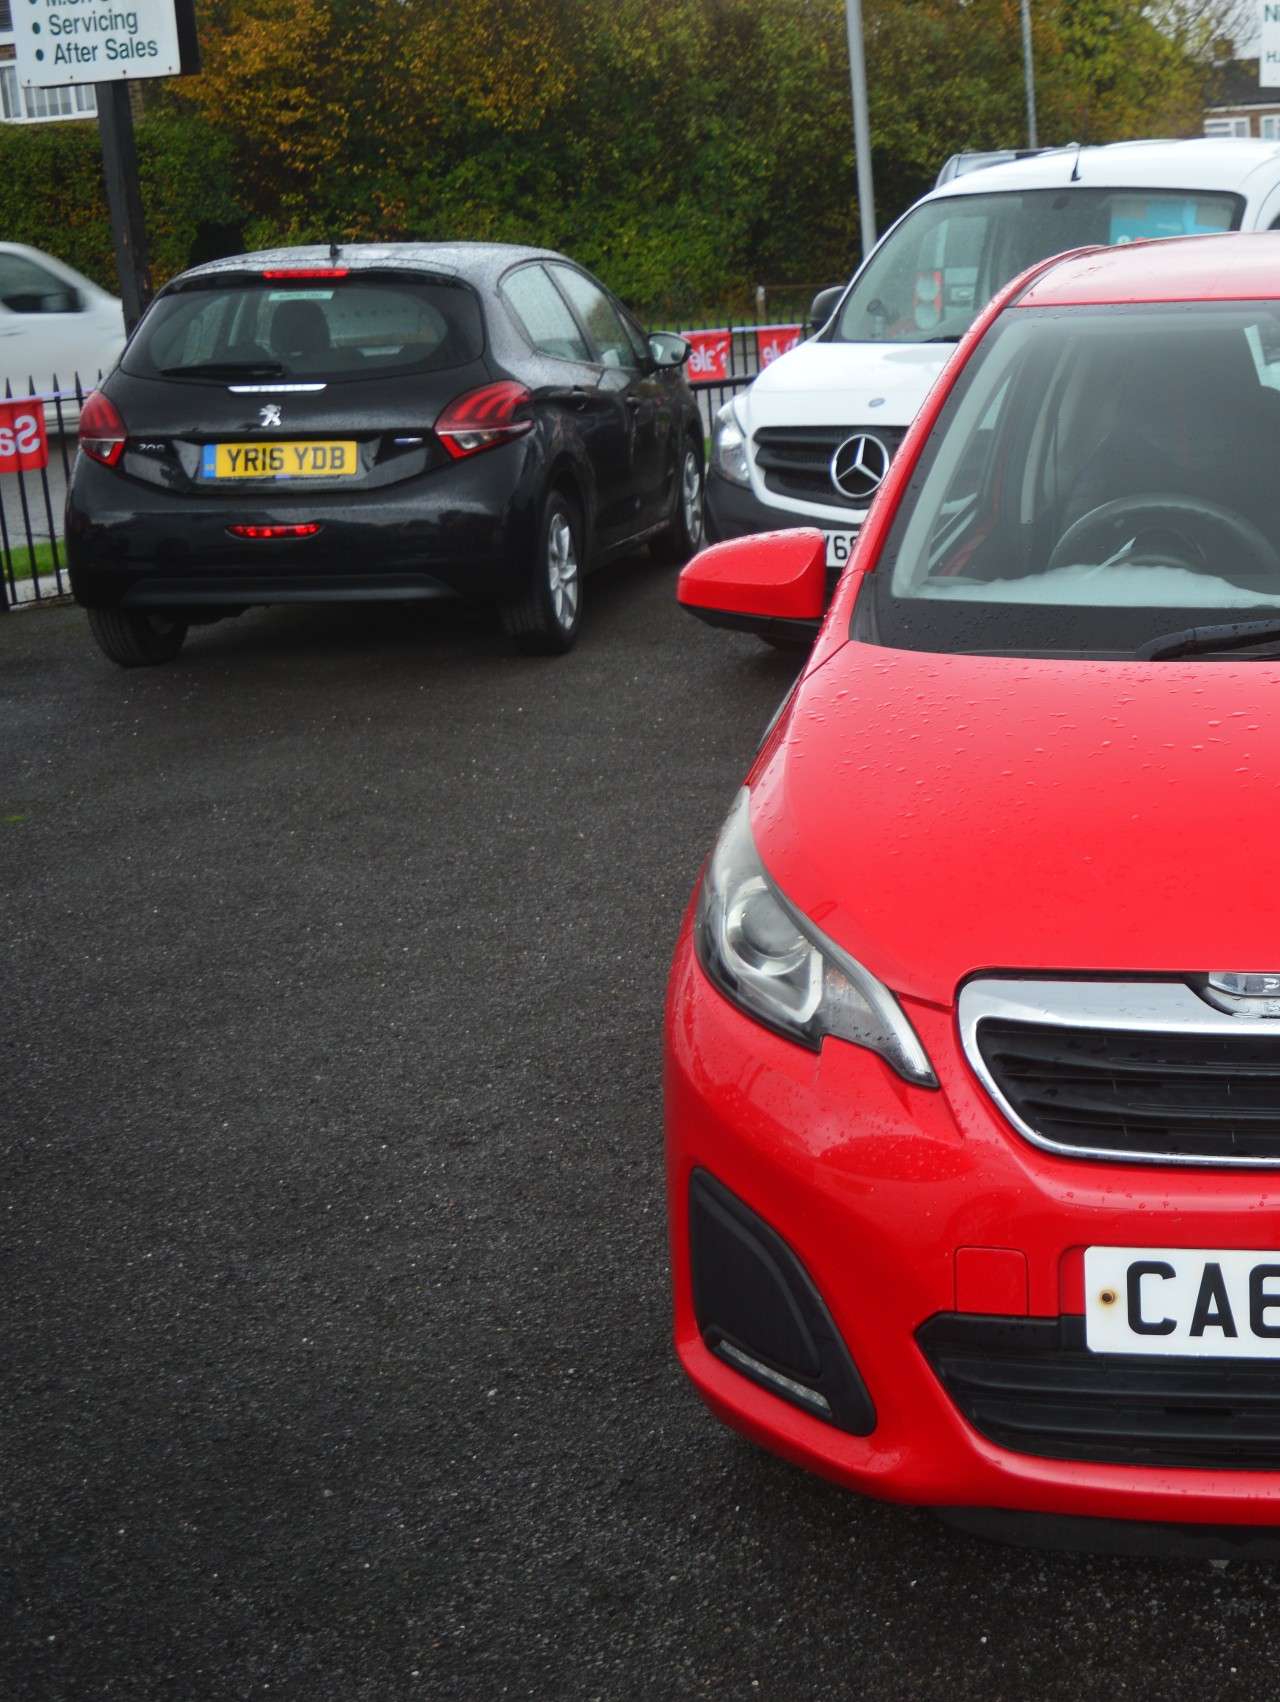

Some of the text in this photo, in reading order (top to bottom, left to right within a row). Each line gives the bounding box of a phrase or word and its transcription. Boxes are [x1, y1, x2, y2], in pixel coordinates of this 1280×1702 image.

[48, 8, 139, 34] Servicing
[54, 38, 159, 65] After Sales
[294, 446, 345, 470] YDB
